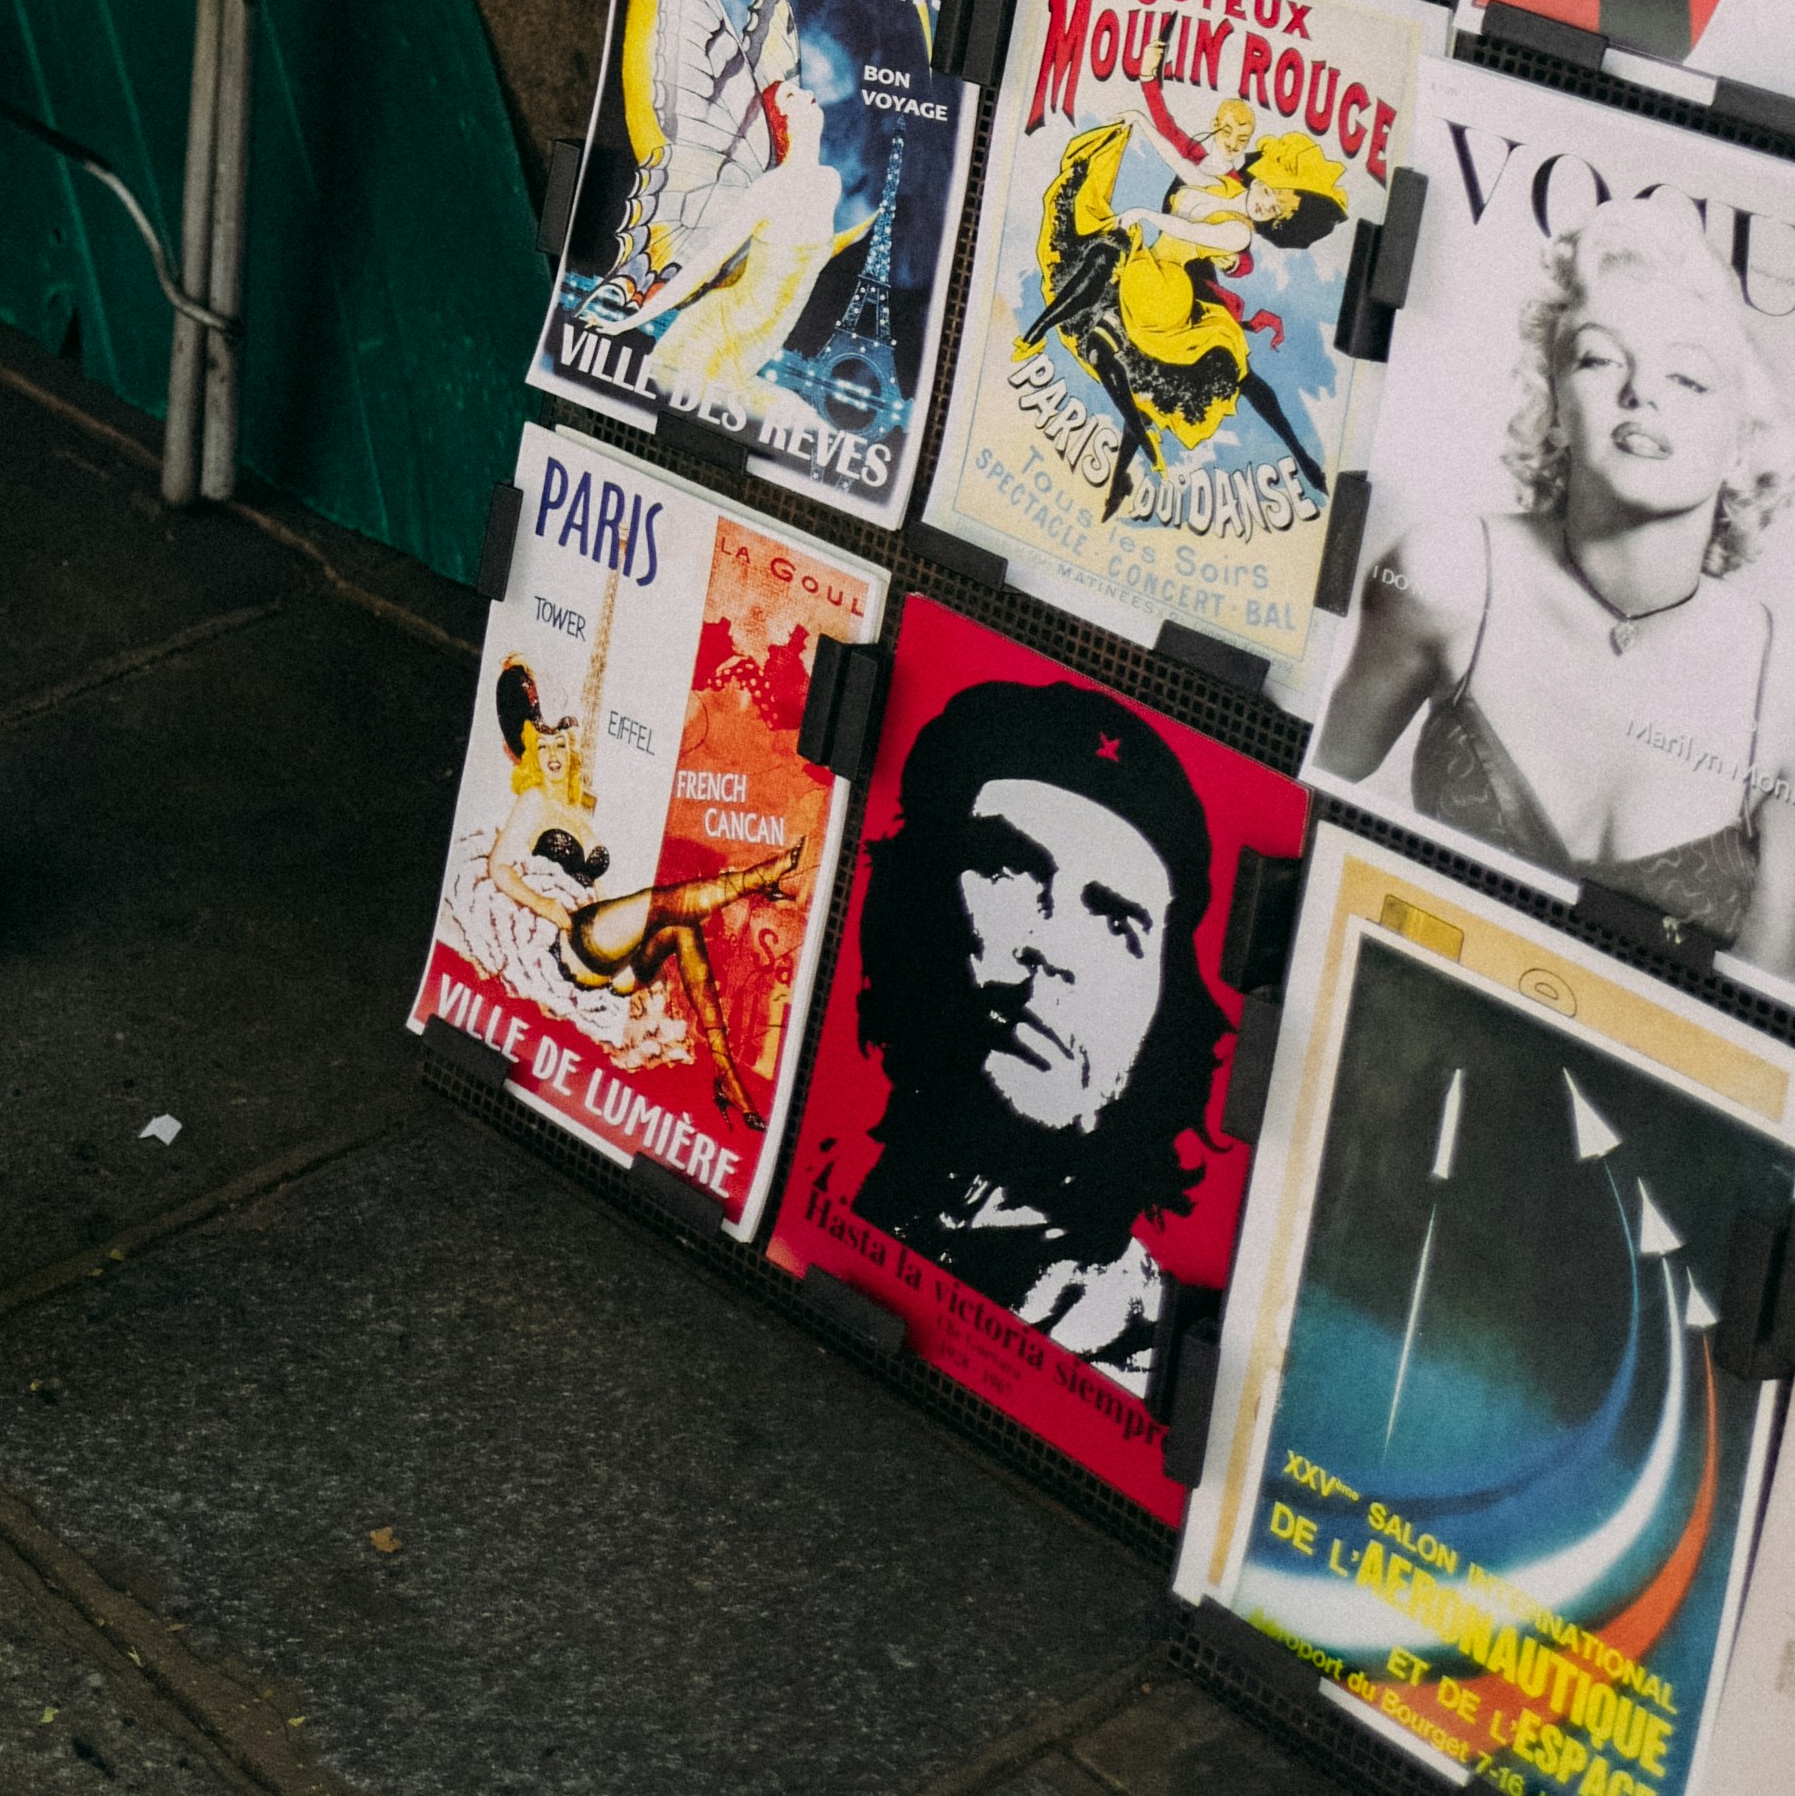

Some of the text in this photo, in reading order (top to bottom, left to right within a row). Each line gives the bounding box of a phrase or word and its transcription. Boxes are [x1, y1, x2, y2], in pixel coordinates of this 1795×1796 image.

[861, 88, 949, 122] VOYAGE
[862, 64, 911, 89] BON
[1238, 29, 1398, 190] ROUGE
[559, 323, 657, 401] VILLE
[668, 377, 750, 433] DES
[1007, 354, 1119, 488] PARIS
[1187, 455, 1322, 545] DANSE
[535, 456, 664, 587] PARIS
[975, 447, 1090, 559] SPECTACLE
[1107, 553, 1227, 616] CONCERT
[1245, 597, 1298, 631] BAL
[1108, 528, 1157, 565] les
[1173, 544, 1270, 591] Soirs
[720, 536, 865, 618] LA GOUL
[534, 595, 586, 642] TOWER
[607, 709, 655, 757] EIFFEL
[675, 770, 748, 803] FRENCH
[704, 807, 785, 847] CANCAN
[437, 972, 740, 1199] VILLE DE LUMIÈRE
[805, 1188, 1167, 1446] Hasta la victoria siempr
[1269, 1500, 1318, 1556] DE
[1368, 1501, 1458, 1575] SALON
[1347, 1671, 1377, 1702] du
[1379, 1687, 1470, 1763] Bourget
[1386, 1645, 1431, 1687] ET
[1436, 1674, 1482, 1726] DE
